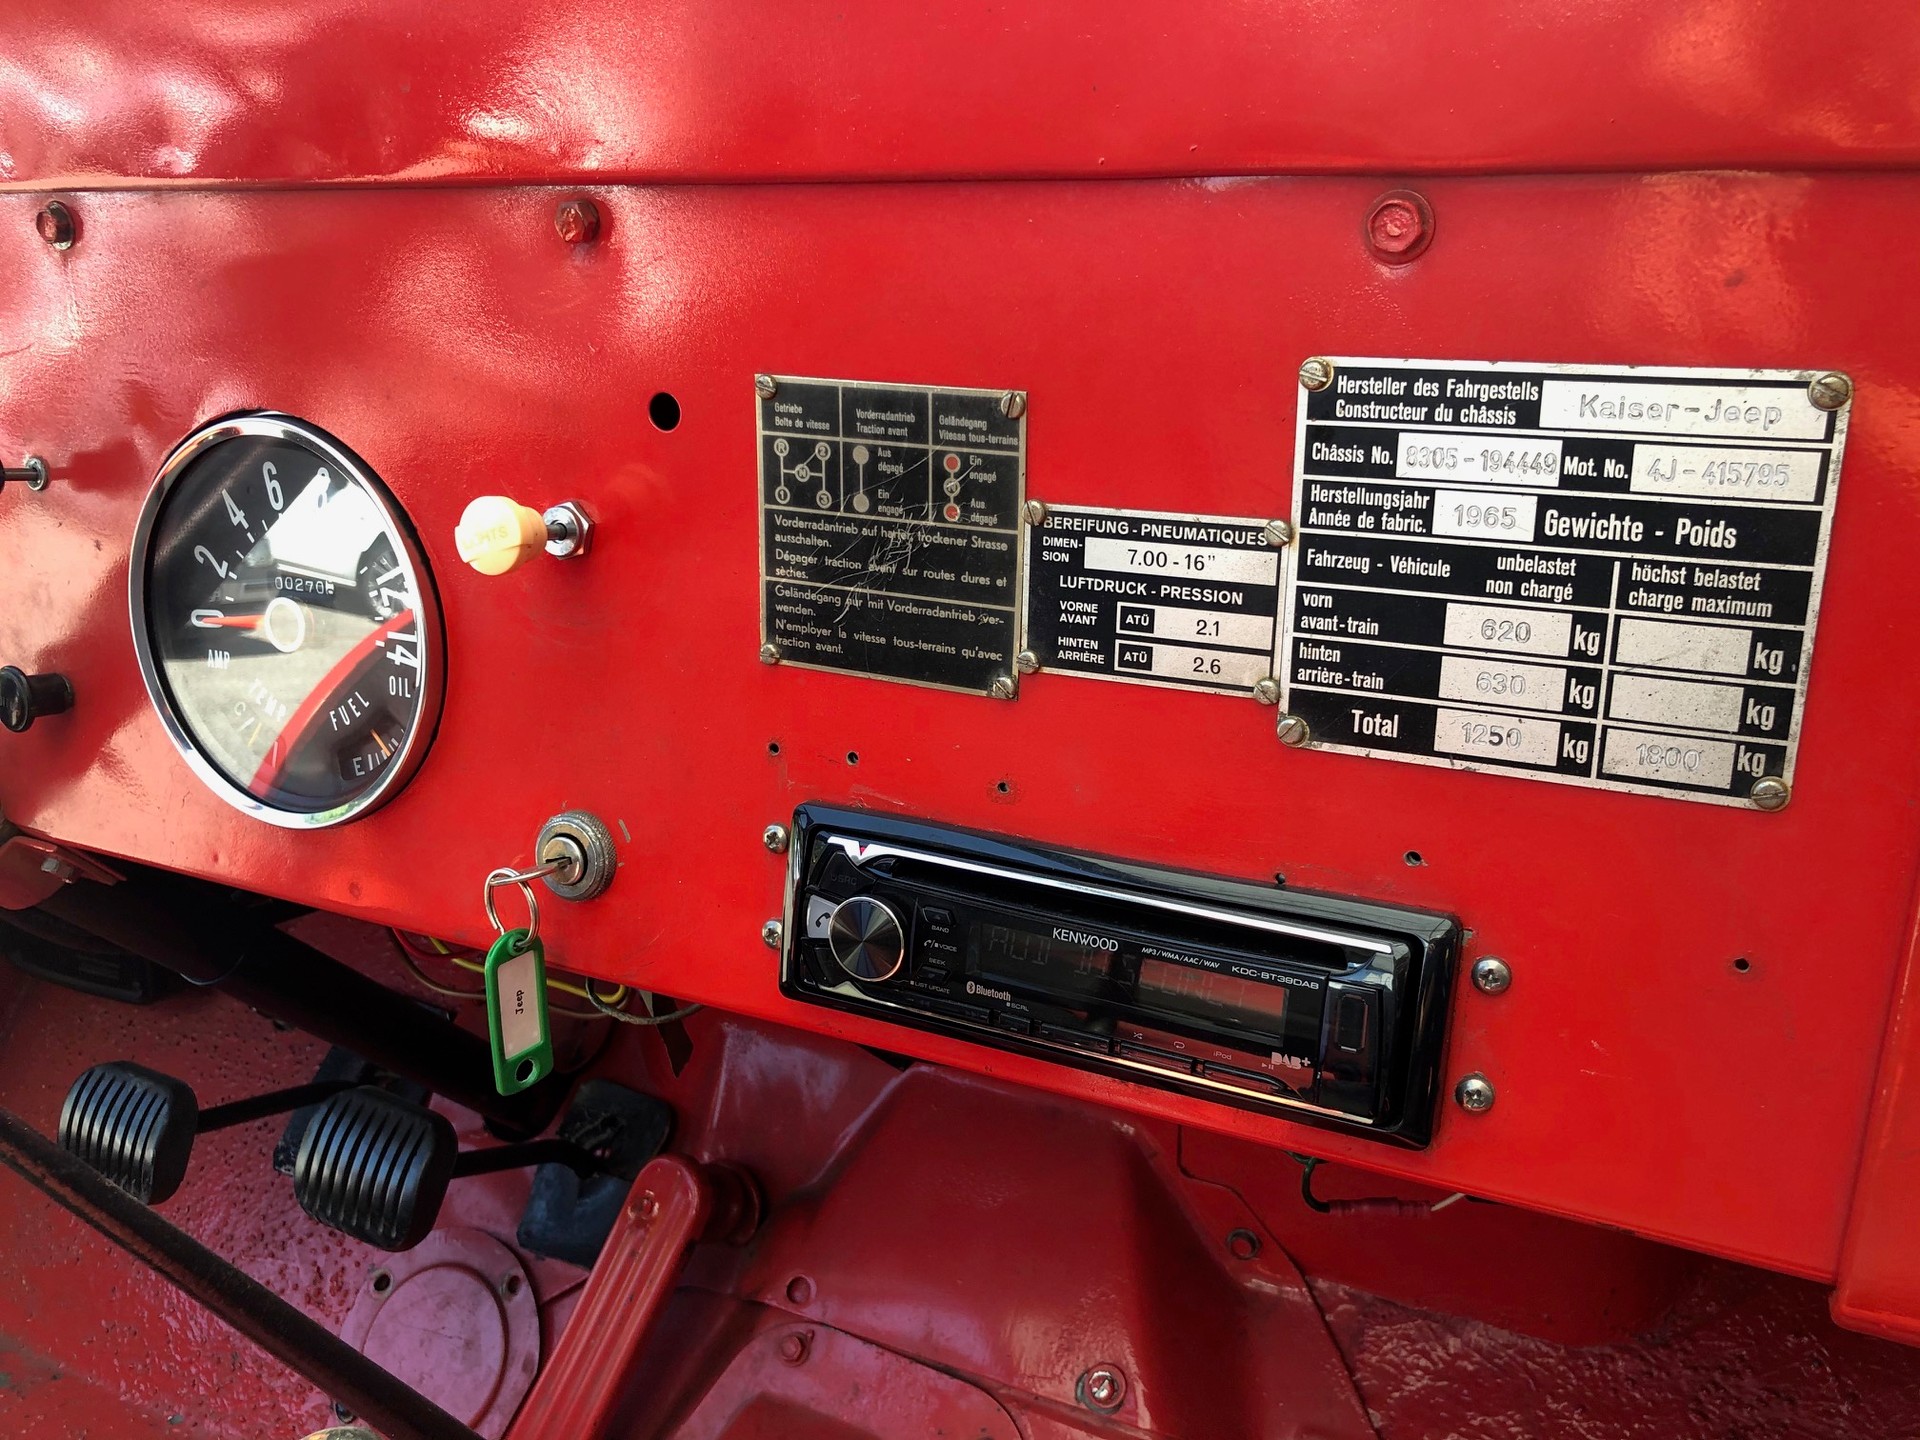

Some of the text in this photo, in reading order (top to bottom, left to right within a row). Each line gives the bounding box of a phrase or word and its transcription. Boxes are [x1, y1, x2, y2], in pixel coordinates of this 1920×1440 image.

[1337, 375, 1539, 402] Hersteller des Fahrgestells
[774, 402, 803, 414] Getriebe
[855, 408, 916, 423] Vorderradantrieb
[1335, 399, 1517, 426] Constructeur du châssis
[1579, 394, 1782, 431] Kaiser-Jeep
[795, 418, 803, 429] de
[806, 420, 830, 431] vitesse
[856, 422, 908, 437] Traction avant
[939, 415, 987, 431] Geländegang
[939, 429, 966, 441] Vitesse
[777, 442, 786, 453] R
[818, 446, 827, 457] 2
[877, 448, 892, 459] Aus
[1311, 442, 1364, 463] Châssis
[1371, 445, 1394, 465] No.
[798, 468, 807, 478] N
[877, 460, 904, 474] dégagé
[969, 471, 997, 483] engagé
[1564, 456, 1597, 477] Mot.
[1604, 458, 1628, 479] No.
[262, 461, 284, 511] 6
[779, 490, 786, 501] 1
[877, 489, 890, 500] Ein
[222, 488, 249, 530] 4
[820, 494, 828, 505] 3
[1310, 484, 1430, 512] Herstellungsjahr
[970, 512, 998, 525] dégagé
[1308, 507, 1427, 534] Année de fabric.
[1454, 503, 1517, 529] 1965
[775, 514, 859, 535] Vorderradantrieb
[861, 525, 877, 537] auf
[918, 531, 967, 548] trockener
[971, 536, 1009, 551] Strasse
[1043, 516, 1129, 535] BEREIFUNG
[1141, 523, 1268, 547] PNEUMATIQUES
[1544, 509, 1643, 542] Gewichte
[1675, 517, 1737, 549] Poids
[774, 533, 832, 548] ausschalten.
[1042, 536, 1083, 549] DIMEN-
[194, 545, 229, 579] 2
[775, 548, 818, 566] Dégager
[825, 556, 862, 571] traction
[902, 568, 918, 577] sur
[923, 569, 956, 581] routes
[961, 571, 991, 586] dures
[996, 576, 1008, 587] et
[1042, 550, 1070, 563] SION
[1127, 549, 1168, 568] 7.00
[1306, 549, 1370, 574] Fahrzeug
[1390, 555, 1451, 578] Véhicule
[1496, 554, 1576, 577] unbelastet
[775, 566, 809, 580] sèches.
[1631, 563, 1762, 591] höchst belastet
[1059, 574, 1147, 597] LUFTDRUCK
[1160, 585, 1243, 606] PRESSION
[1302, 592, 1332, 609] vorn
[1485, 578, 1573, 603] non chargé
[775, 584, 842, 606] Geländegang
[868, 598, 884, 610] mit
[887, 600, 976, 623] Vorderradantrieb
[775, 604, 816, 617] wenden.
[1059, 600, 1099, 614] VORNE
[1628, 589, 1773, 618] charge maximum
[190, 608, 225, 629] 0
[1059, 613, 1097, 626] AVANT
[1125, 613, 1220, 637] ATÜ 2.1
[1300, 614, 1379, 636] avant-train
[775, 619, 1003, 662] N'employer la vitesse tous-terrains qu'avec
[775, 635, 844, 655] traction avant.
[1057, 636, 1099, 650] HINTEN
[1481, 618, 1600, 655] 620 kg
[207, 649, 230, 670] AMP
[386, 630, 418, 668] 14
[1057, 650, 1105, 665] ARRIÈRE
[1299, 642, 1341, 663] hinten
[1753, 642, 1784, 676] kg
[1123, 651, 1221, 675] ATÜ 2.6
[389, 675, 411, 698] OIL
[1297, 666, 1384, 690] arrière-train
[1475, 671, 1596, 709] 630 kg
[328, 691, 370, 732] FUEL
[1746, 698, 1776, 731] kg
[1352, 709, 1589, 764] Total 1250 kg
[352, 758, 365, 777] E
[1636, 743, 1766, 778] 1800 kg
[931, 925, 950, 934] BAND
[1052, 927, 1120, 952] KENWOOD
[515, 989, 525, 1015] Jeep
[975, 984, 1011, 1002] Bluetooth
[1213, 1050, 1232, 1060] iPod
[1271, 1051, 1311, 1070] DAB+
